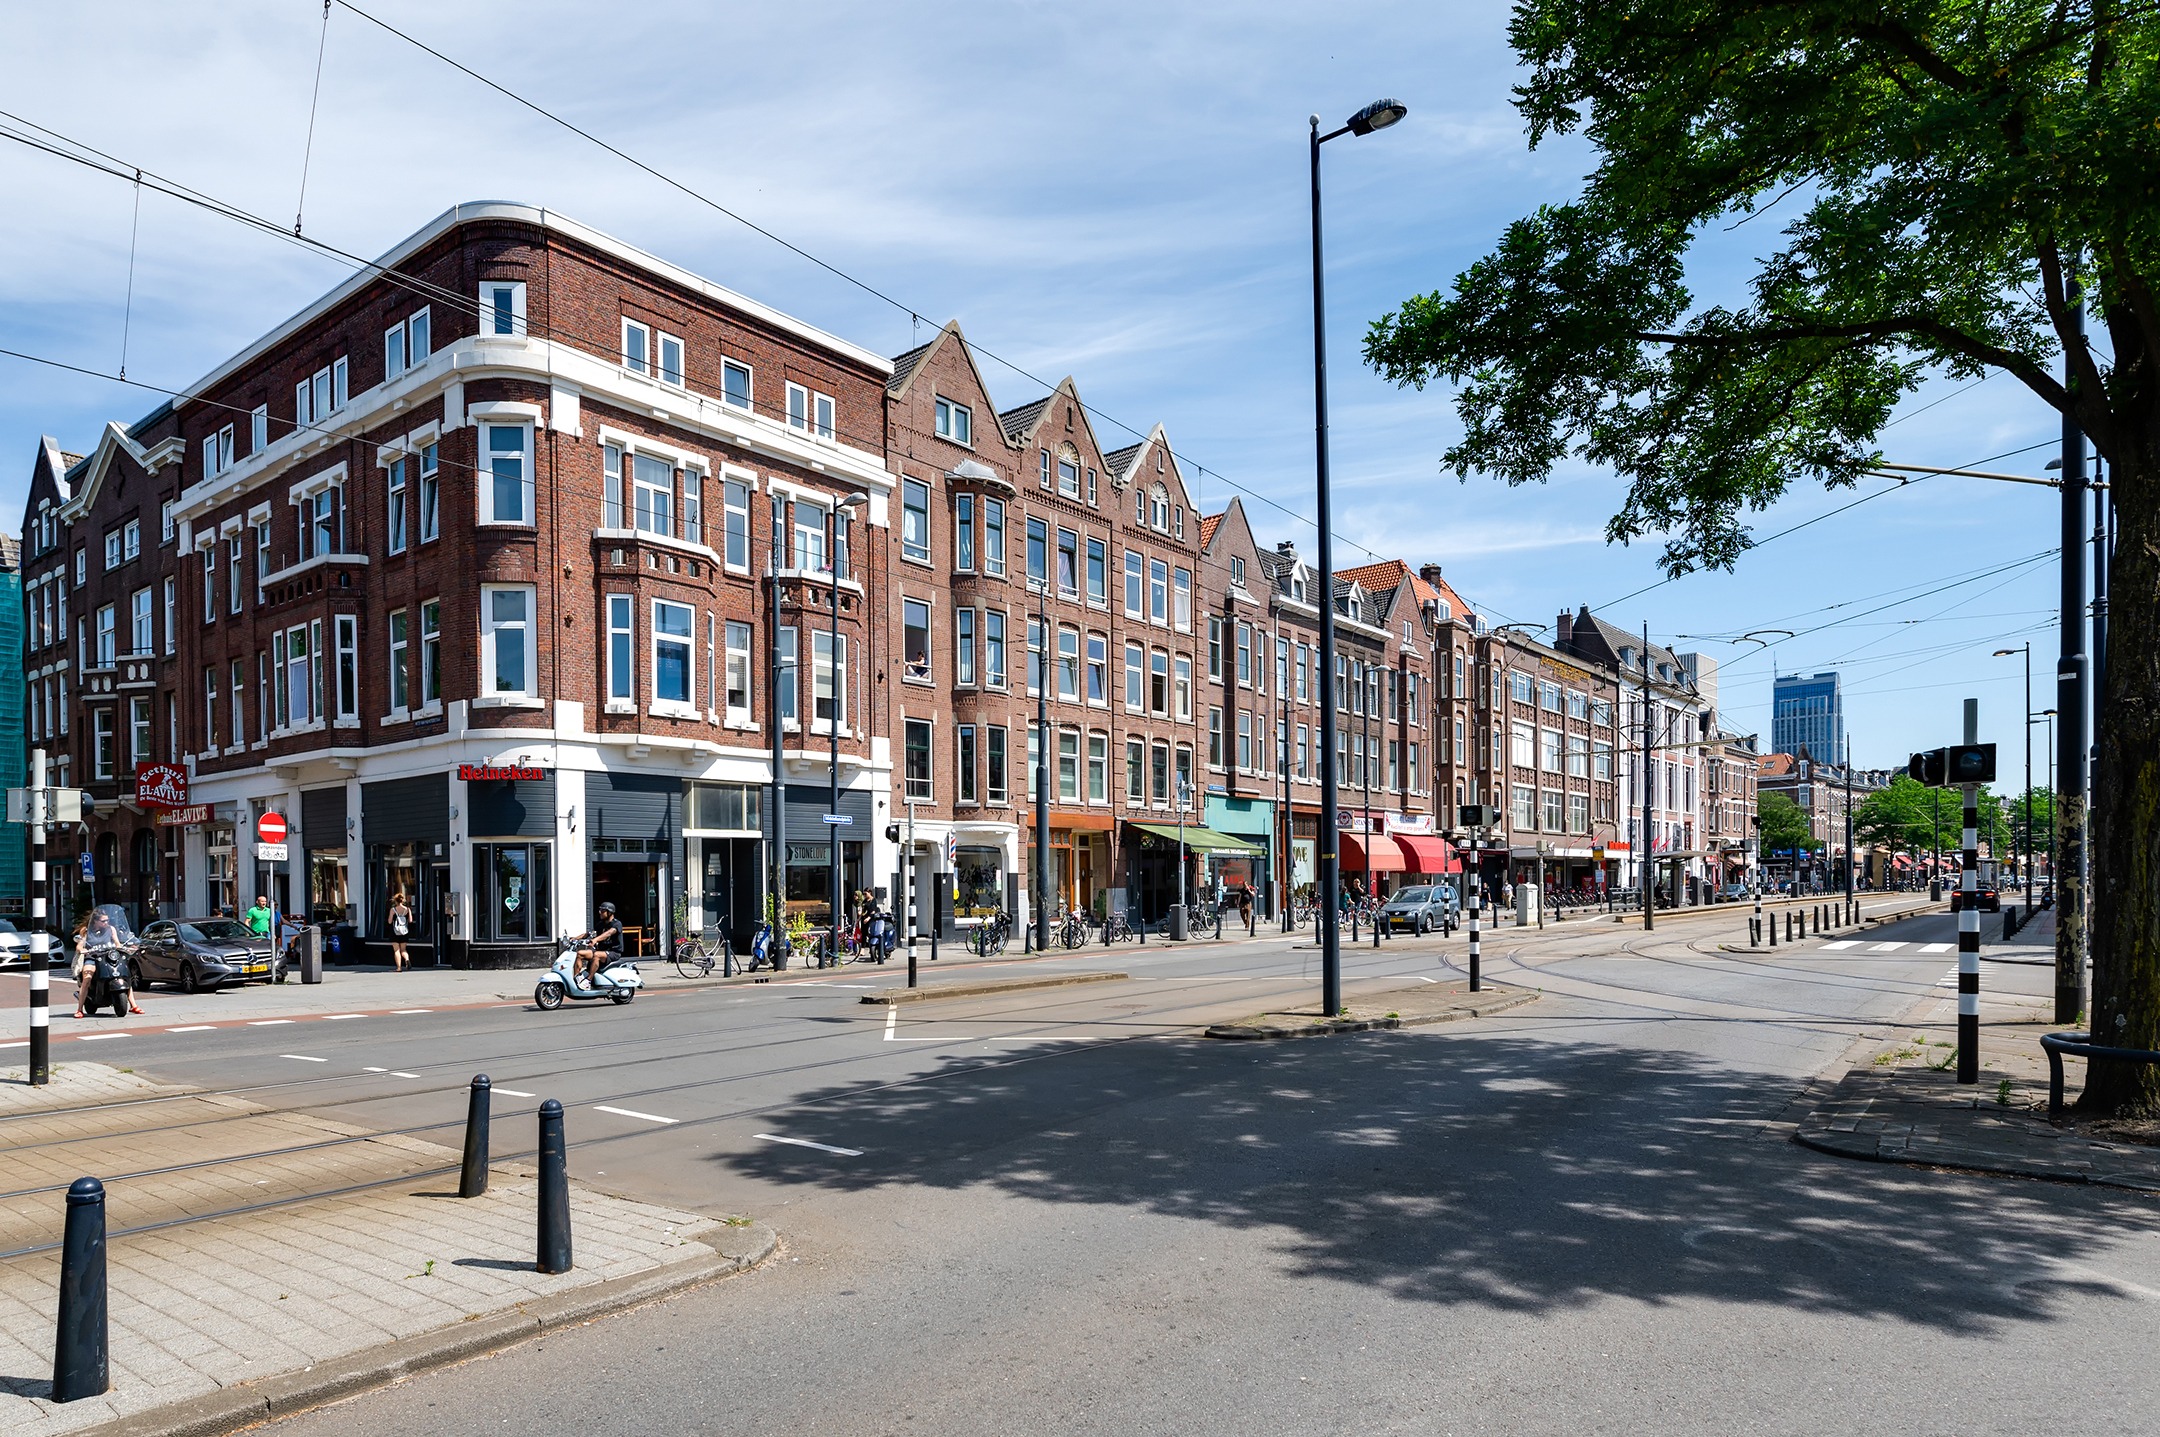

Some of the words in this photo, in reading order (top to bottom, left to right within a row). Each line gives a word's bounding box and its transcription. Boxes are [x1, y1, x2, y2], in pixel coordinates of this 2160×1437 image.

[140, 765, 185, 785] Eethuis
[459, 763, 544, 780] Heineken
[157, 813, 172, 824] Eethuis
[794, 847, 826, 859] STONELOVE
[83, 854, 90, 866] P
